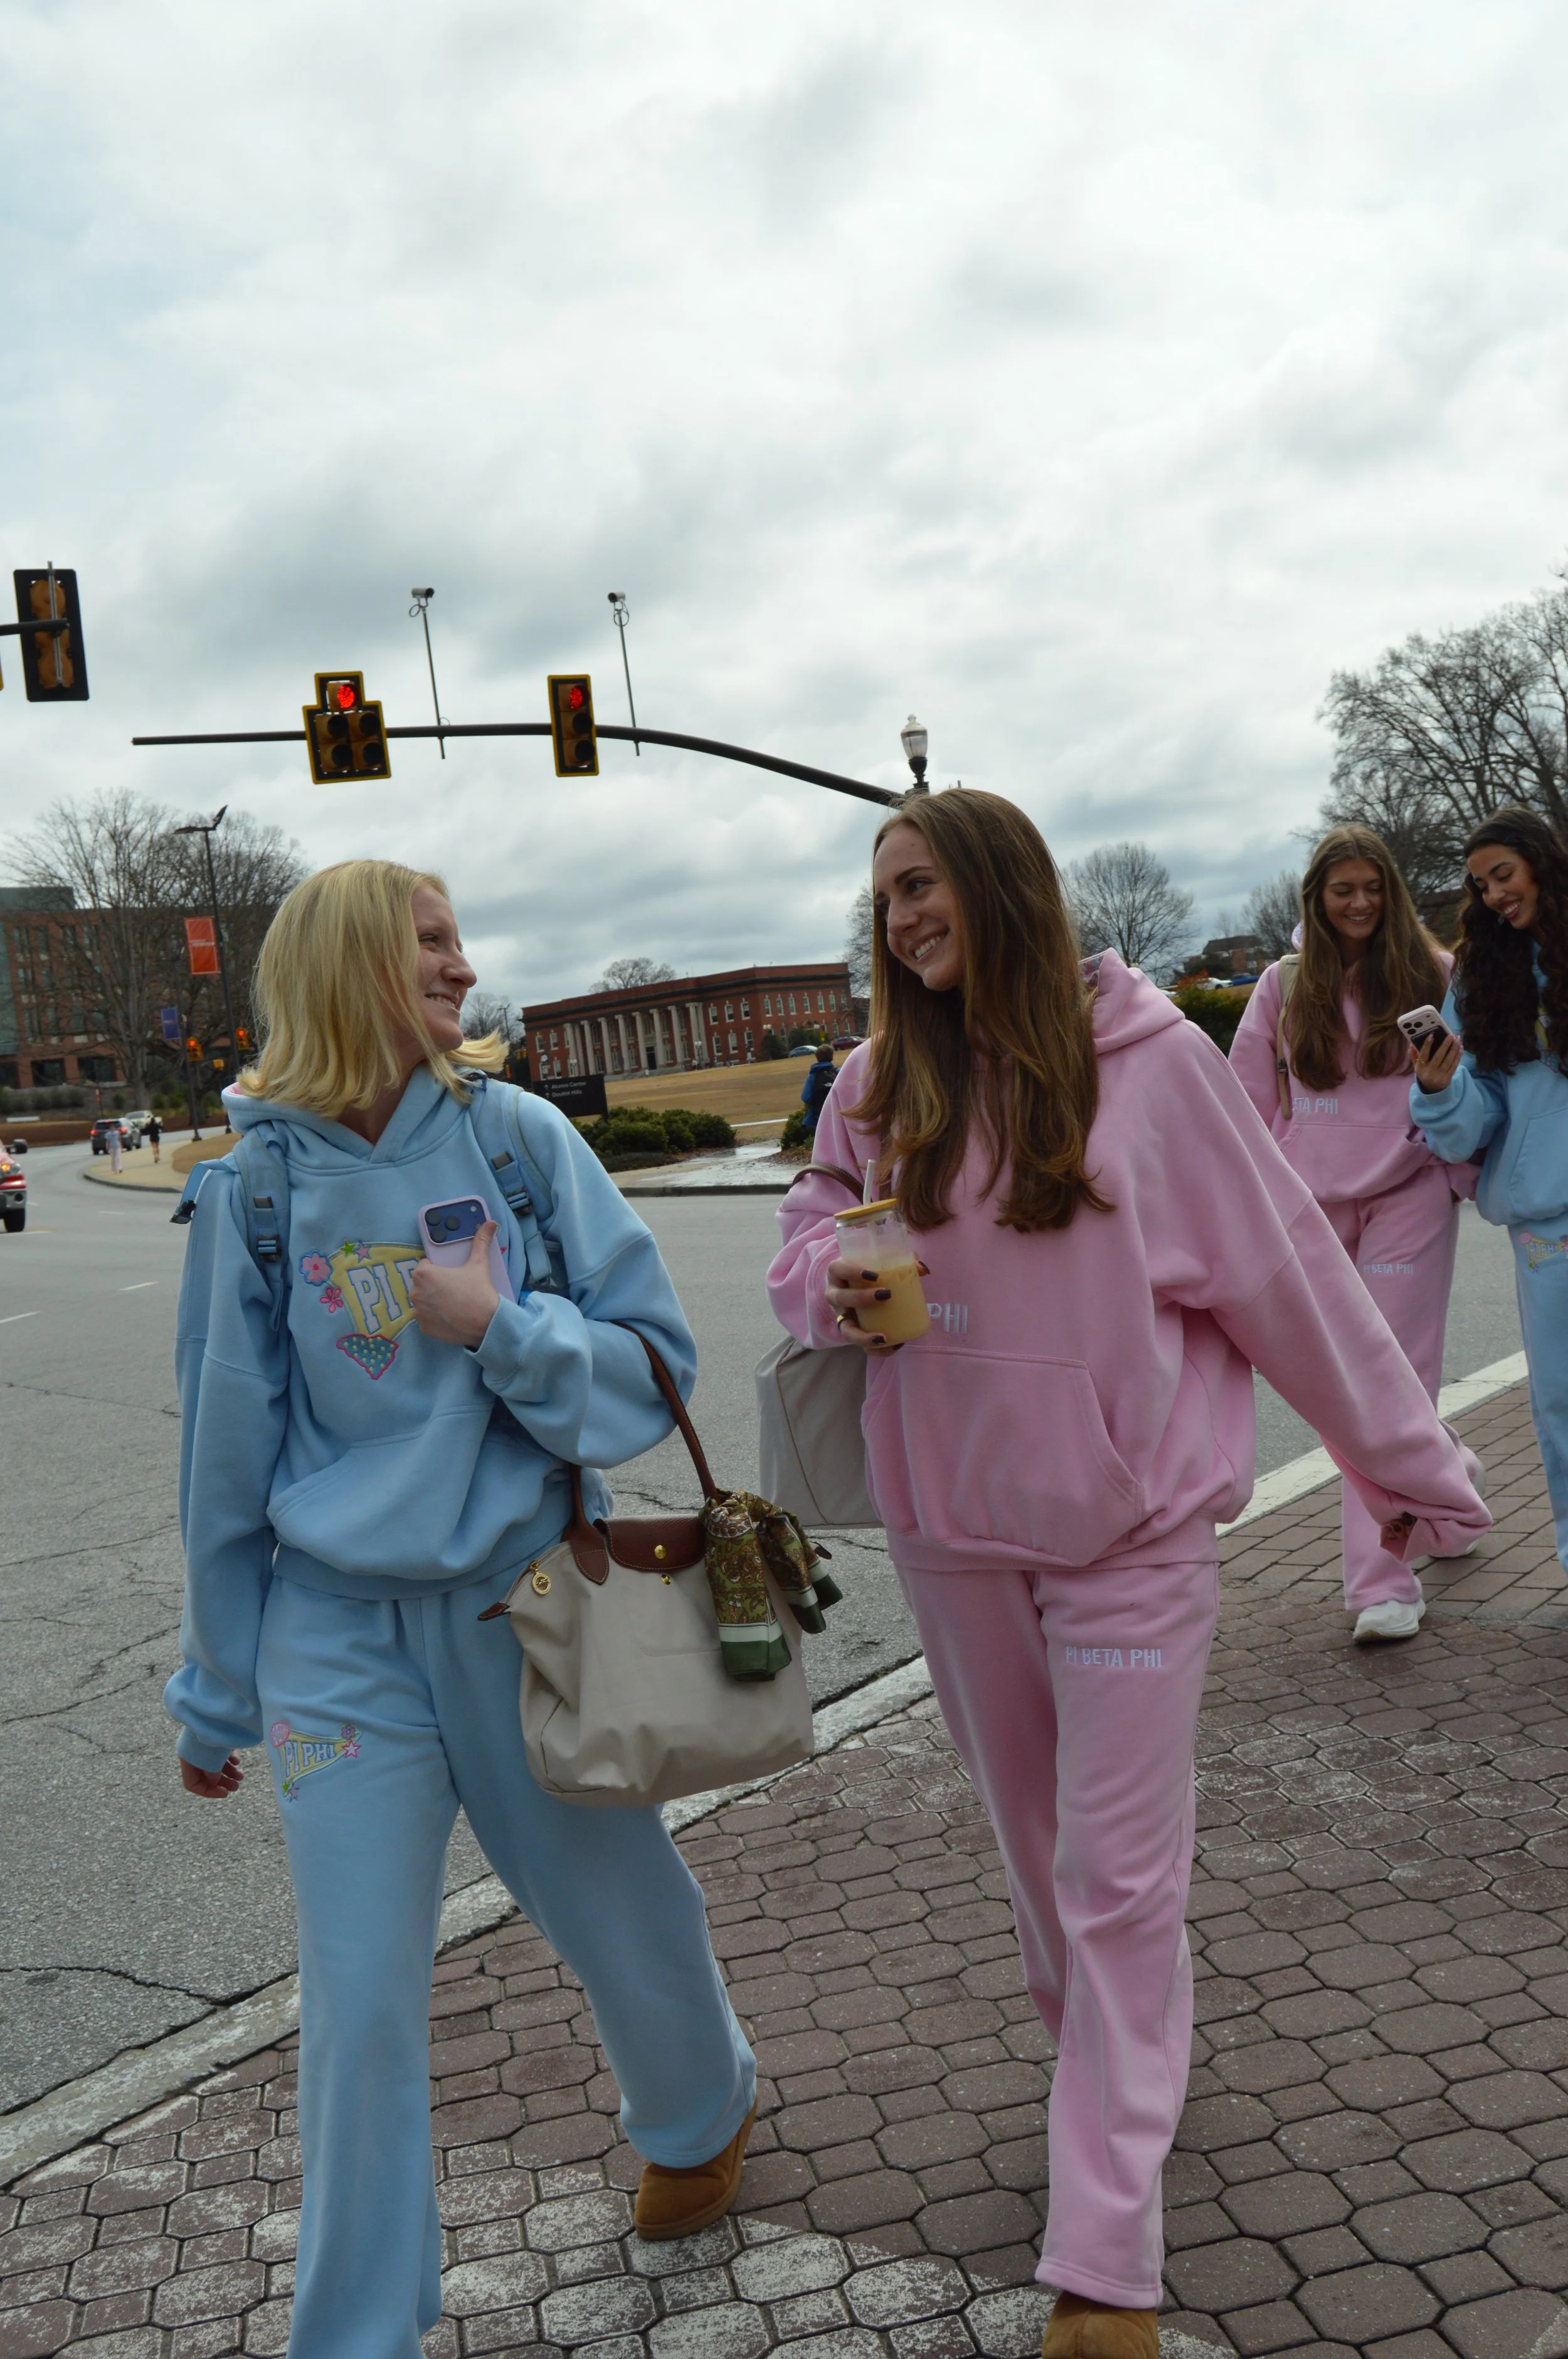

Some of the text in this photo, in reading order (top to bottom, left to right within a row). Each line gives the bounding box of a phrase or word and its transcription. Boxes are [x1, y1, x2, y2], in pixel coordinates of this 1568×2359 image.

[1292, 1097, 1338, 1114] ETA PHI
[1541, 1243, 1558, 1255] PHI
[1372, 1264, 1393, 1274] BETA
[1397, 1264, 1413, 1274] PHI
[347, 1263, 402, 1334] PI
[926, 1302, 968, 1334] PHI
[1066, 1646, 1162, 1668] PI BETA PHI
[284, 1740, 337, 1778] PI PHI
